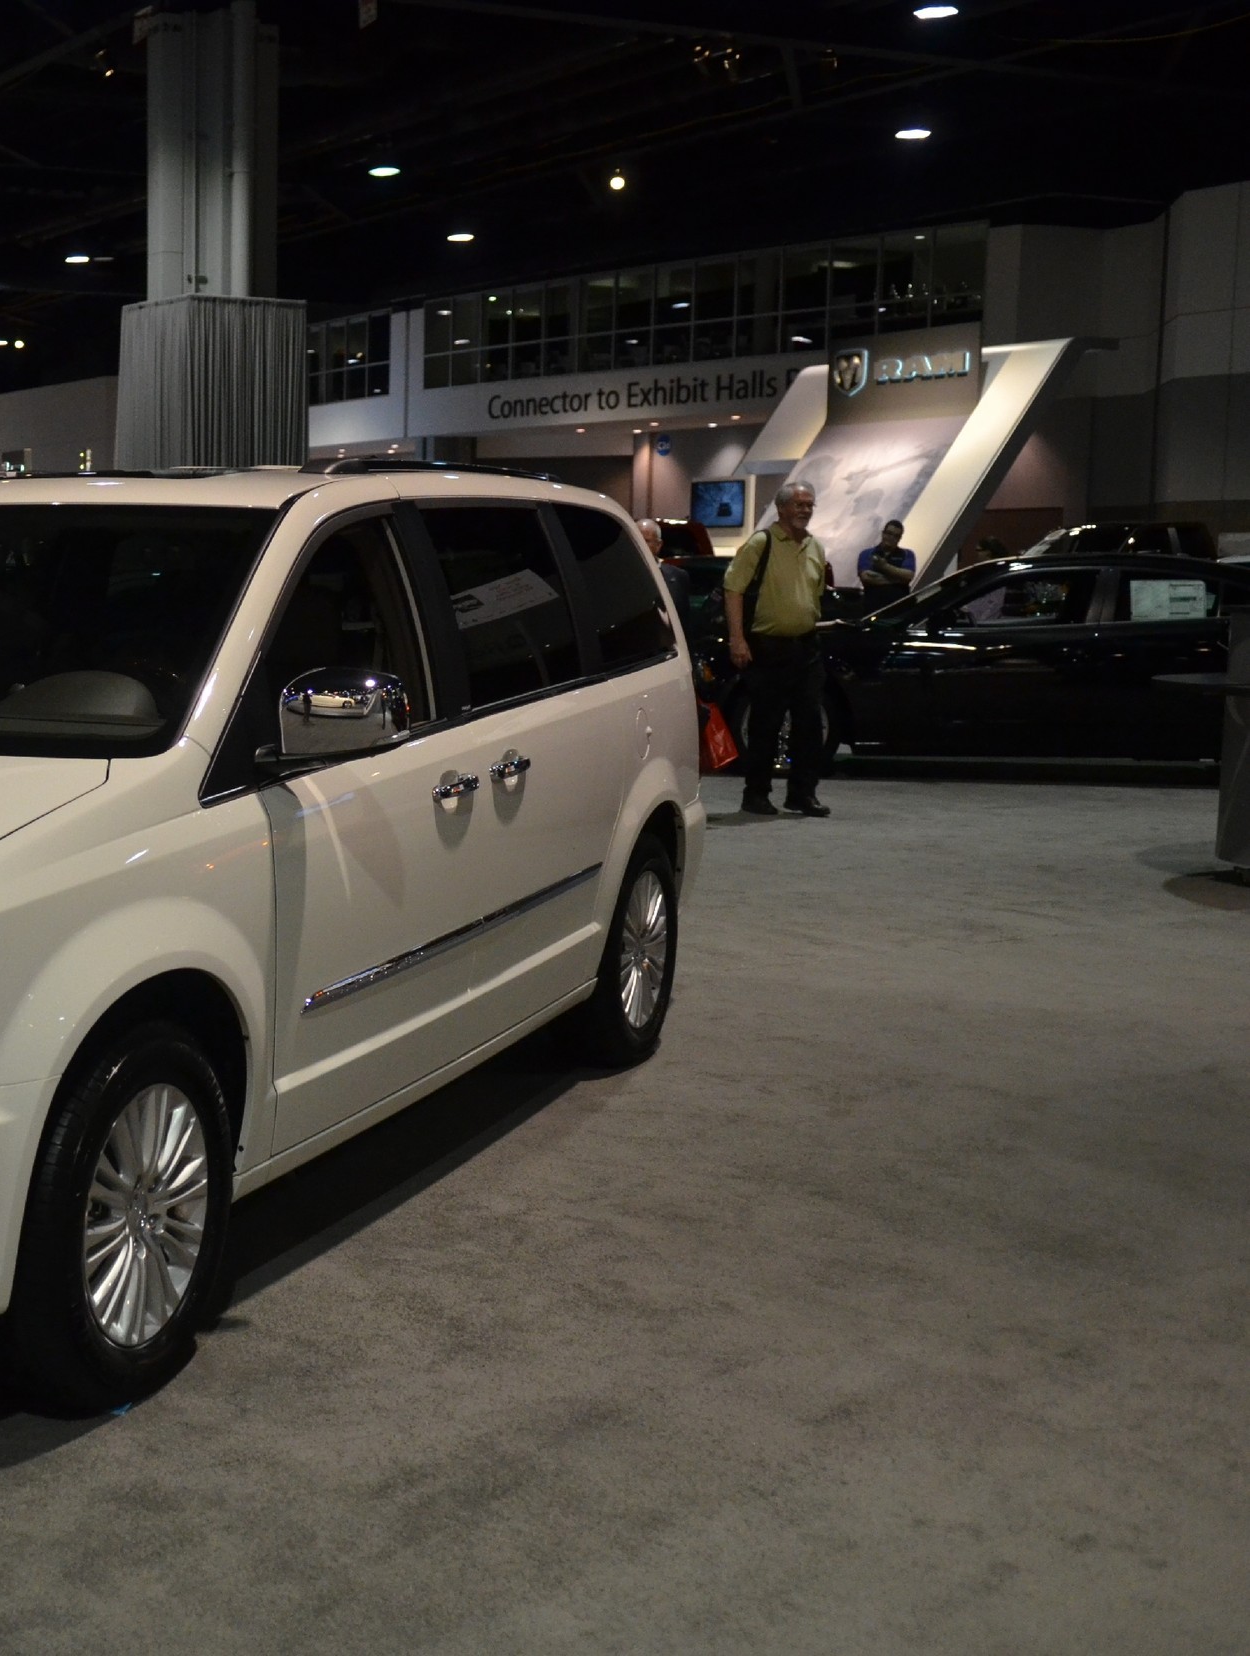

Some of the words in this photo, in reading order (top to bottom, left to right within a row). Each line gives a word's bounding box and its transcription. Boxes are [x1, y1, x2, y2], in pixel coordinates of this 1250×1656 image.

[874, 351, 971, 385] RAM
[487, 390, 592, 419] Connector
[596, 387, 620, 410] to
[626, 376, 710, 408] Exhibit
[716, 369, 778, 401] Halls
